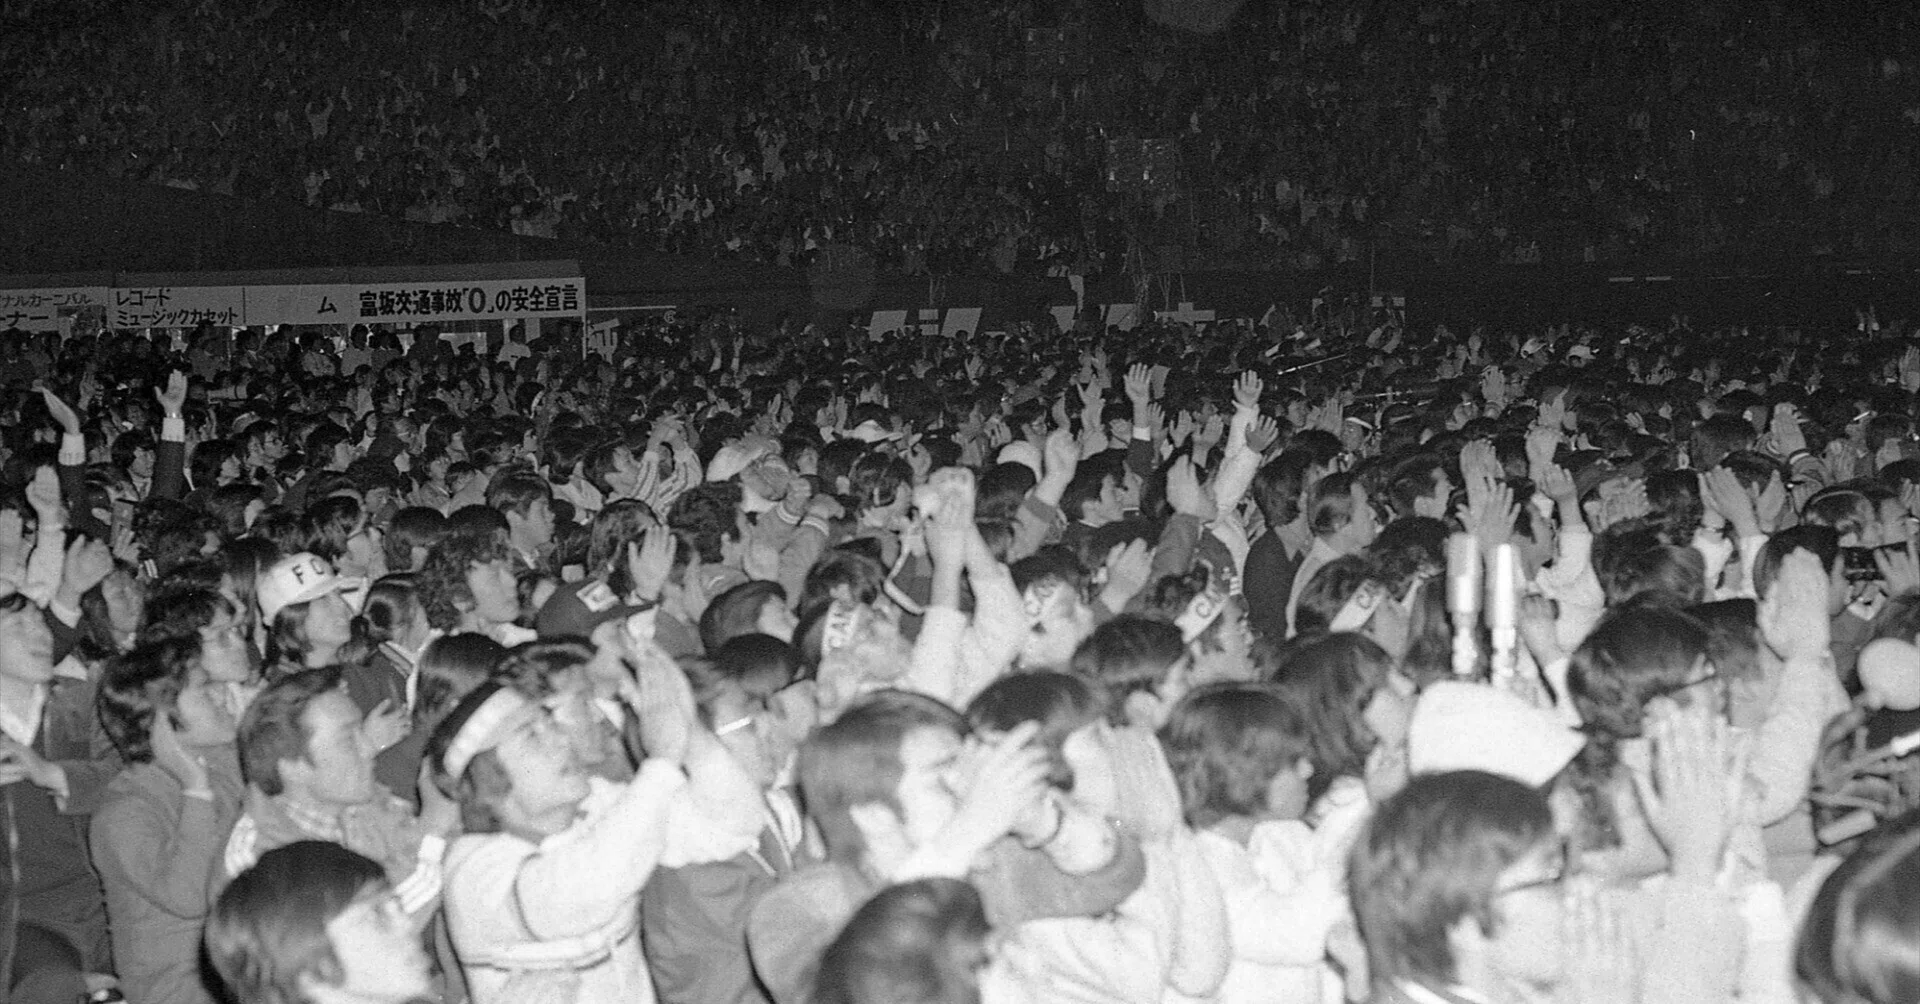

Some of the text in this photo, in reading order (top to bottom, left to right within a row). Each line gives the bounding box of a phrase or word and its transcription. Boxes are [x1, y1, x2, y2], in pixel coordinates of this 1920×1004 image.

[0, 292, 92, 308] ナルカーニバル
[116, 289, 170, 306] レコード
[117, 306, 237, 327] ミュージックカセット
